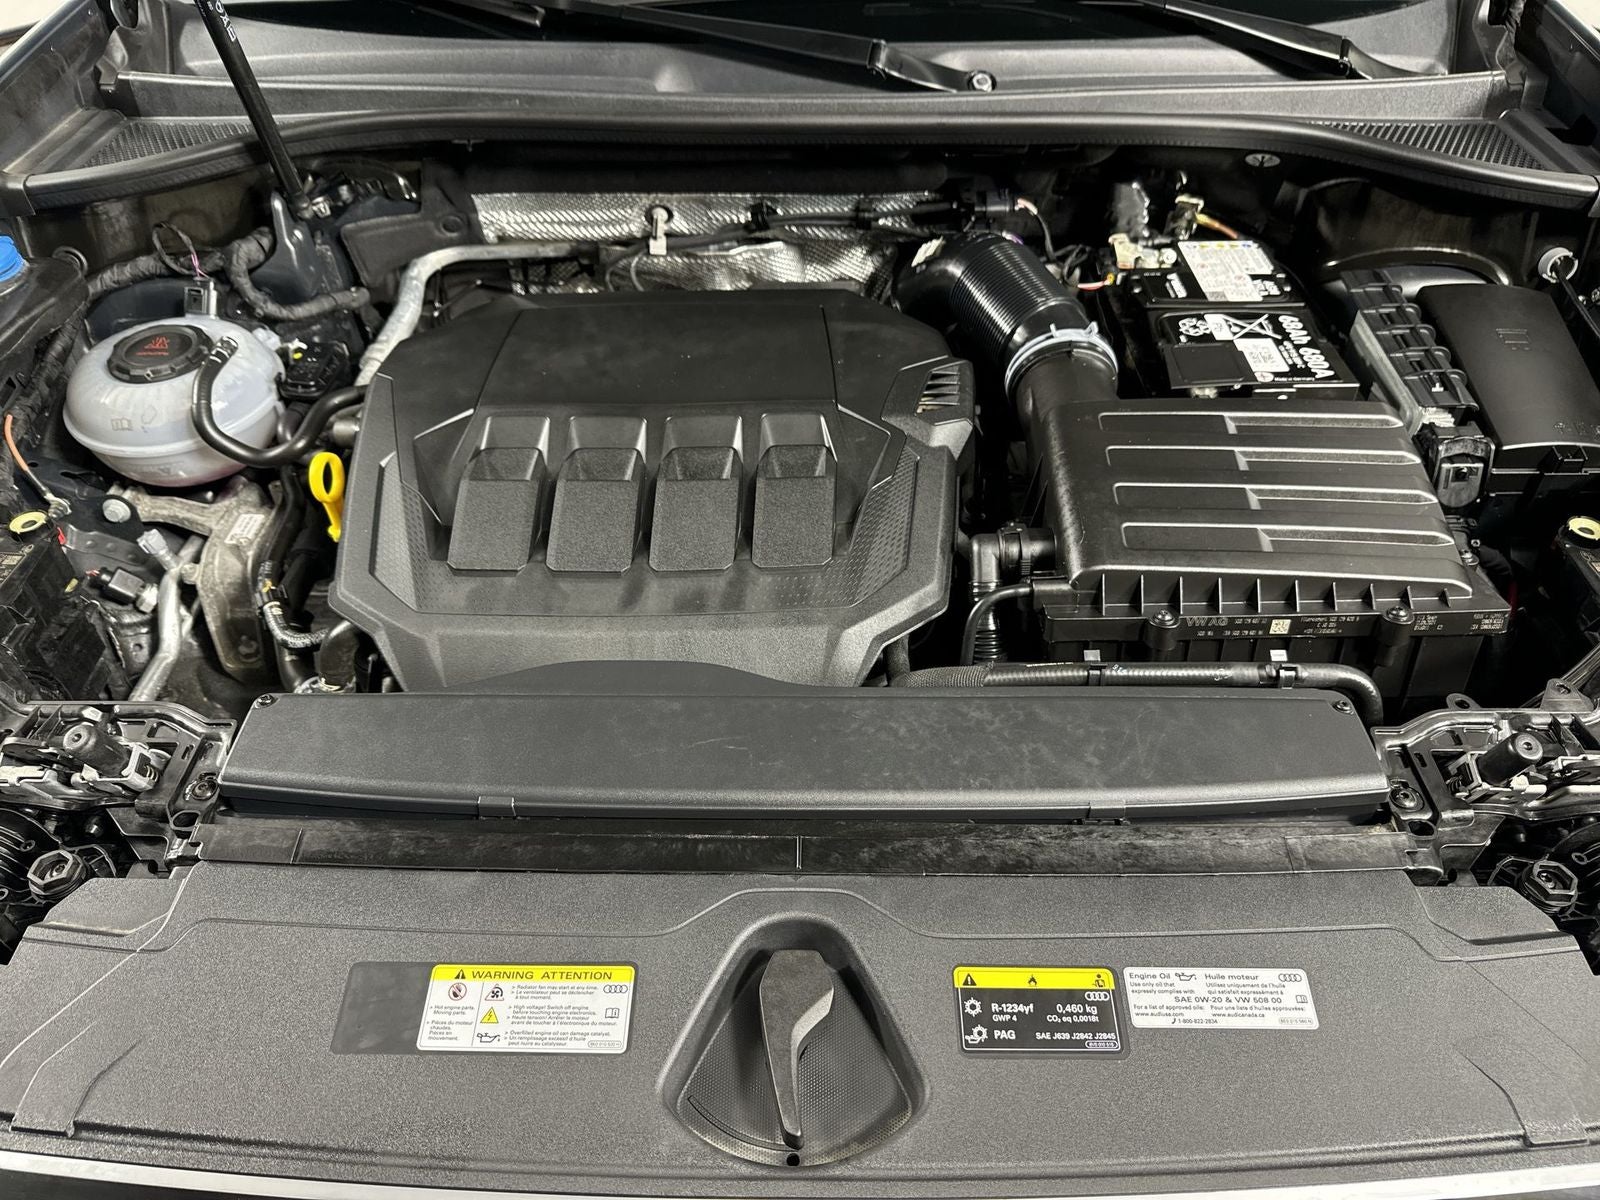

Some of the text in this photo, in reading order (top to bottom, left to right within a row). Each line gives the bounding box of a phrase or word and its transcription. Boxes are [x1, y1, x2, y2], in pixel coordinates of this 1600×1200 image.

[1278, 315, 1312, 344] 68Ah
[1299, 347, 1335, 379] 680A
[1186, 617, 1208, 627] VW
[1208, 617, 1229, 626] AG
[472, 971, 613, 980] WARNING ATTENTION
[991, 1003, 1098, 1015] R-1234yf 0,460 kg
[1062, 1016, 1072, 1024] eq
[994, 1030, 1016, 1040] PAG
[1053, 1032, 1071, 1040] J639
[1071, 1032, 1093, 1040] J2842
[1094, 1032, 1116, 1040] J2845
